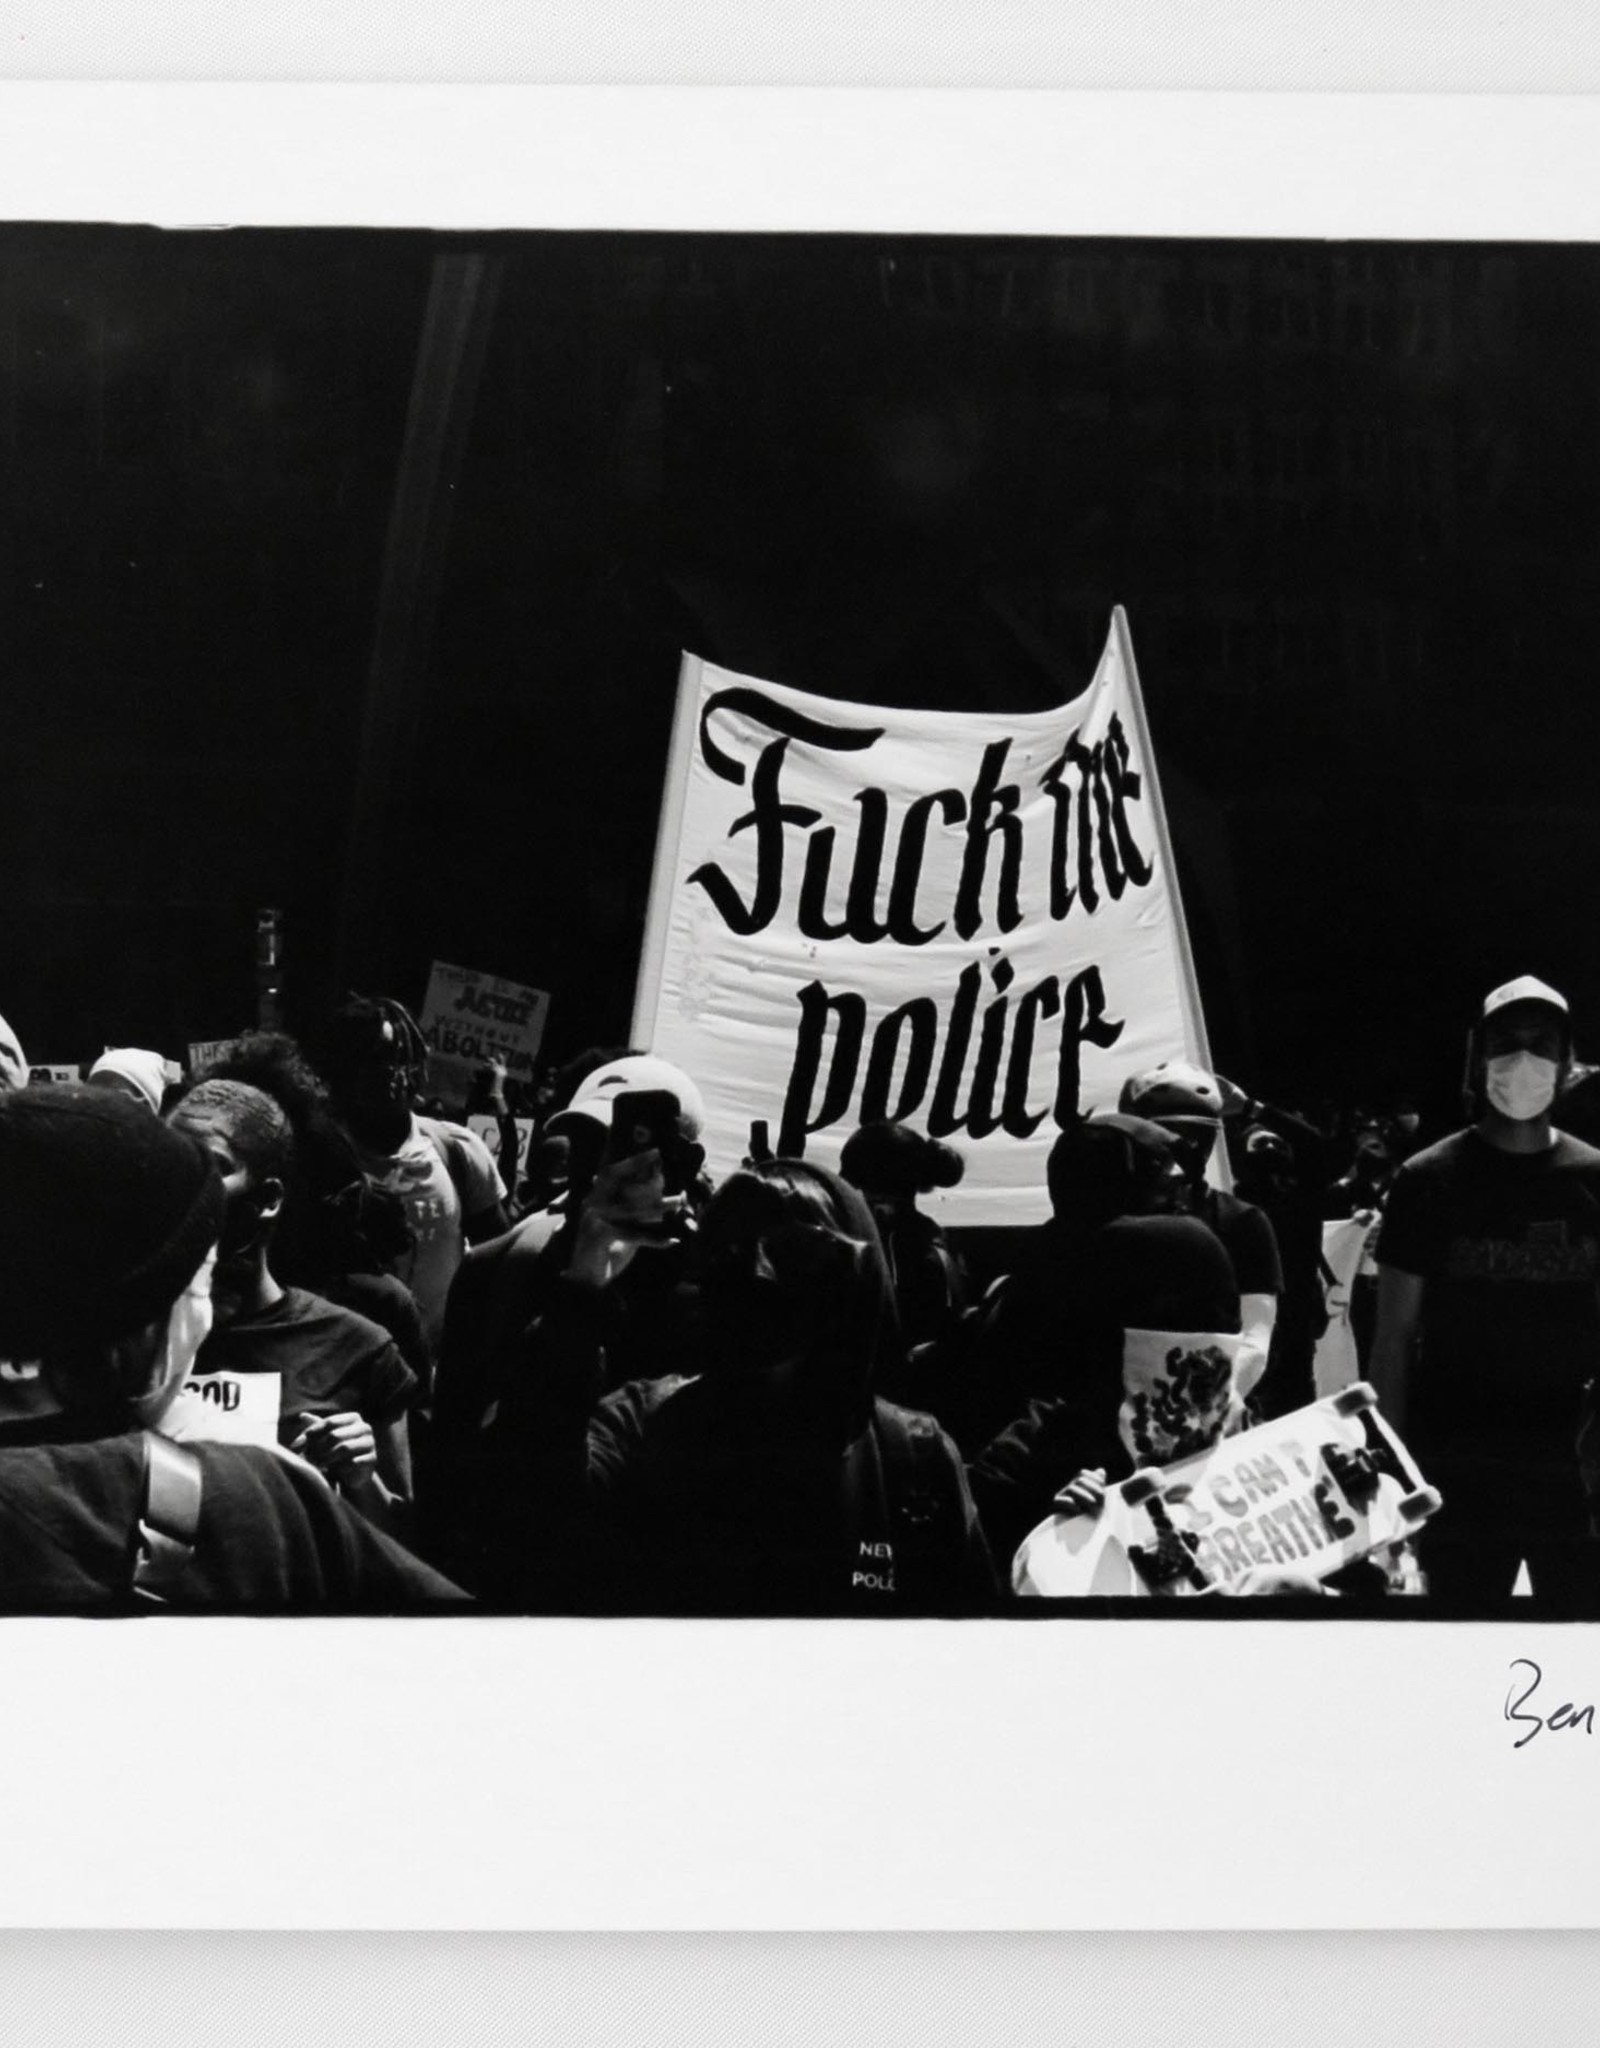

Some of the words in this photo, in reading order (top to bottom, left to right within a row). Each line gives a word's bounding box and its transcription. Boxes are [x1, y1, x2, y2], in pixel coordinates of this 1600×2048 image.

[687, 687, 1023, 946] Fuck
[1038, 711, 1154, 921] the
[778, 947, 1126, 1158] police
[1504, 1658, 1595, 1748] Ben
